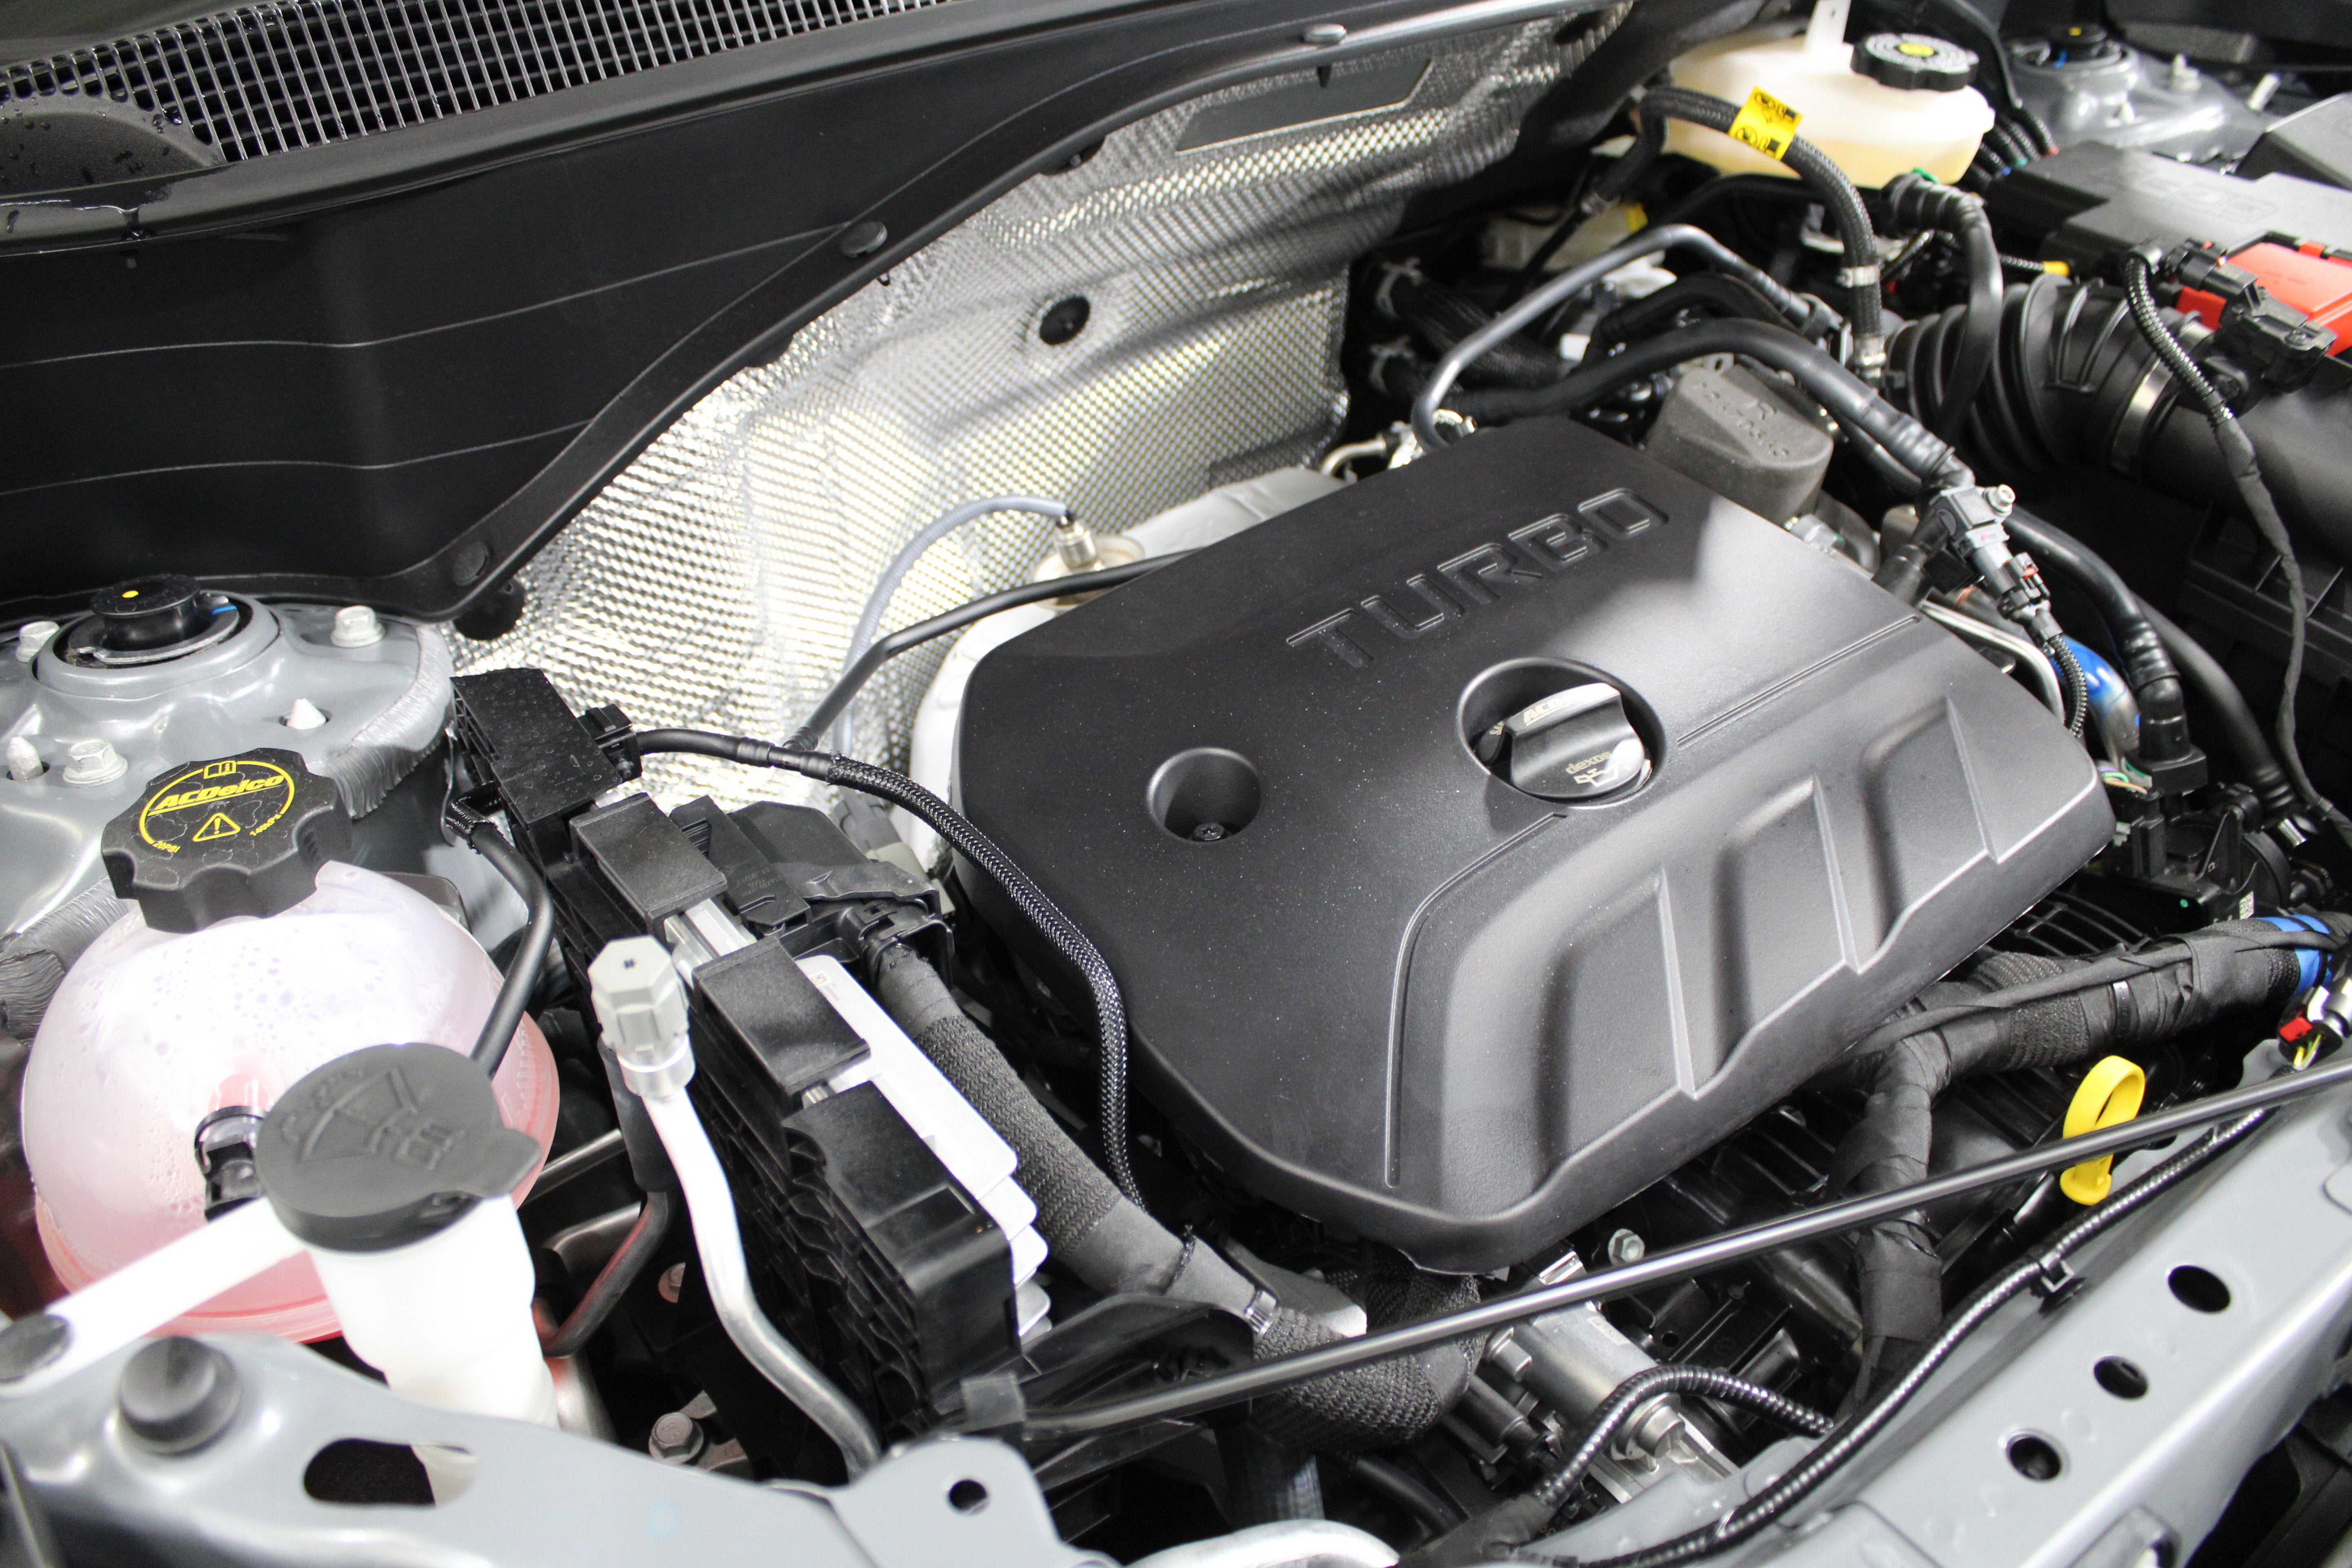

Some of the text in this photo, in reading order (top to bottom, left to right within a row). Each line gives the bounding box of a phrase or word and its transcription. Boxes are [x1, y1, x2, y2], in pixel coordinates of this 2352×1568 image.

[1286, 488, 1669, 668] TURBO
[1565, 751, 1612, 774] dexos
[154, 775, 285, 811] ACDelco
[249, 814, 283, 836] 140kPa
[152, 840, 181, 853] 20PSI
